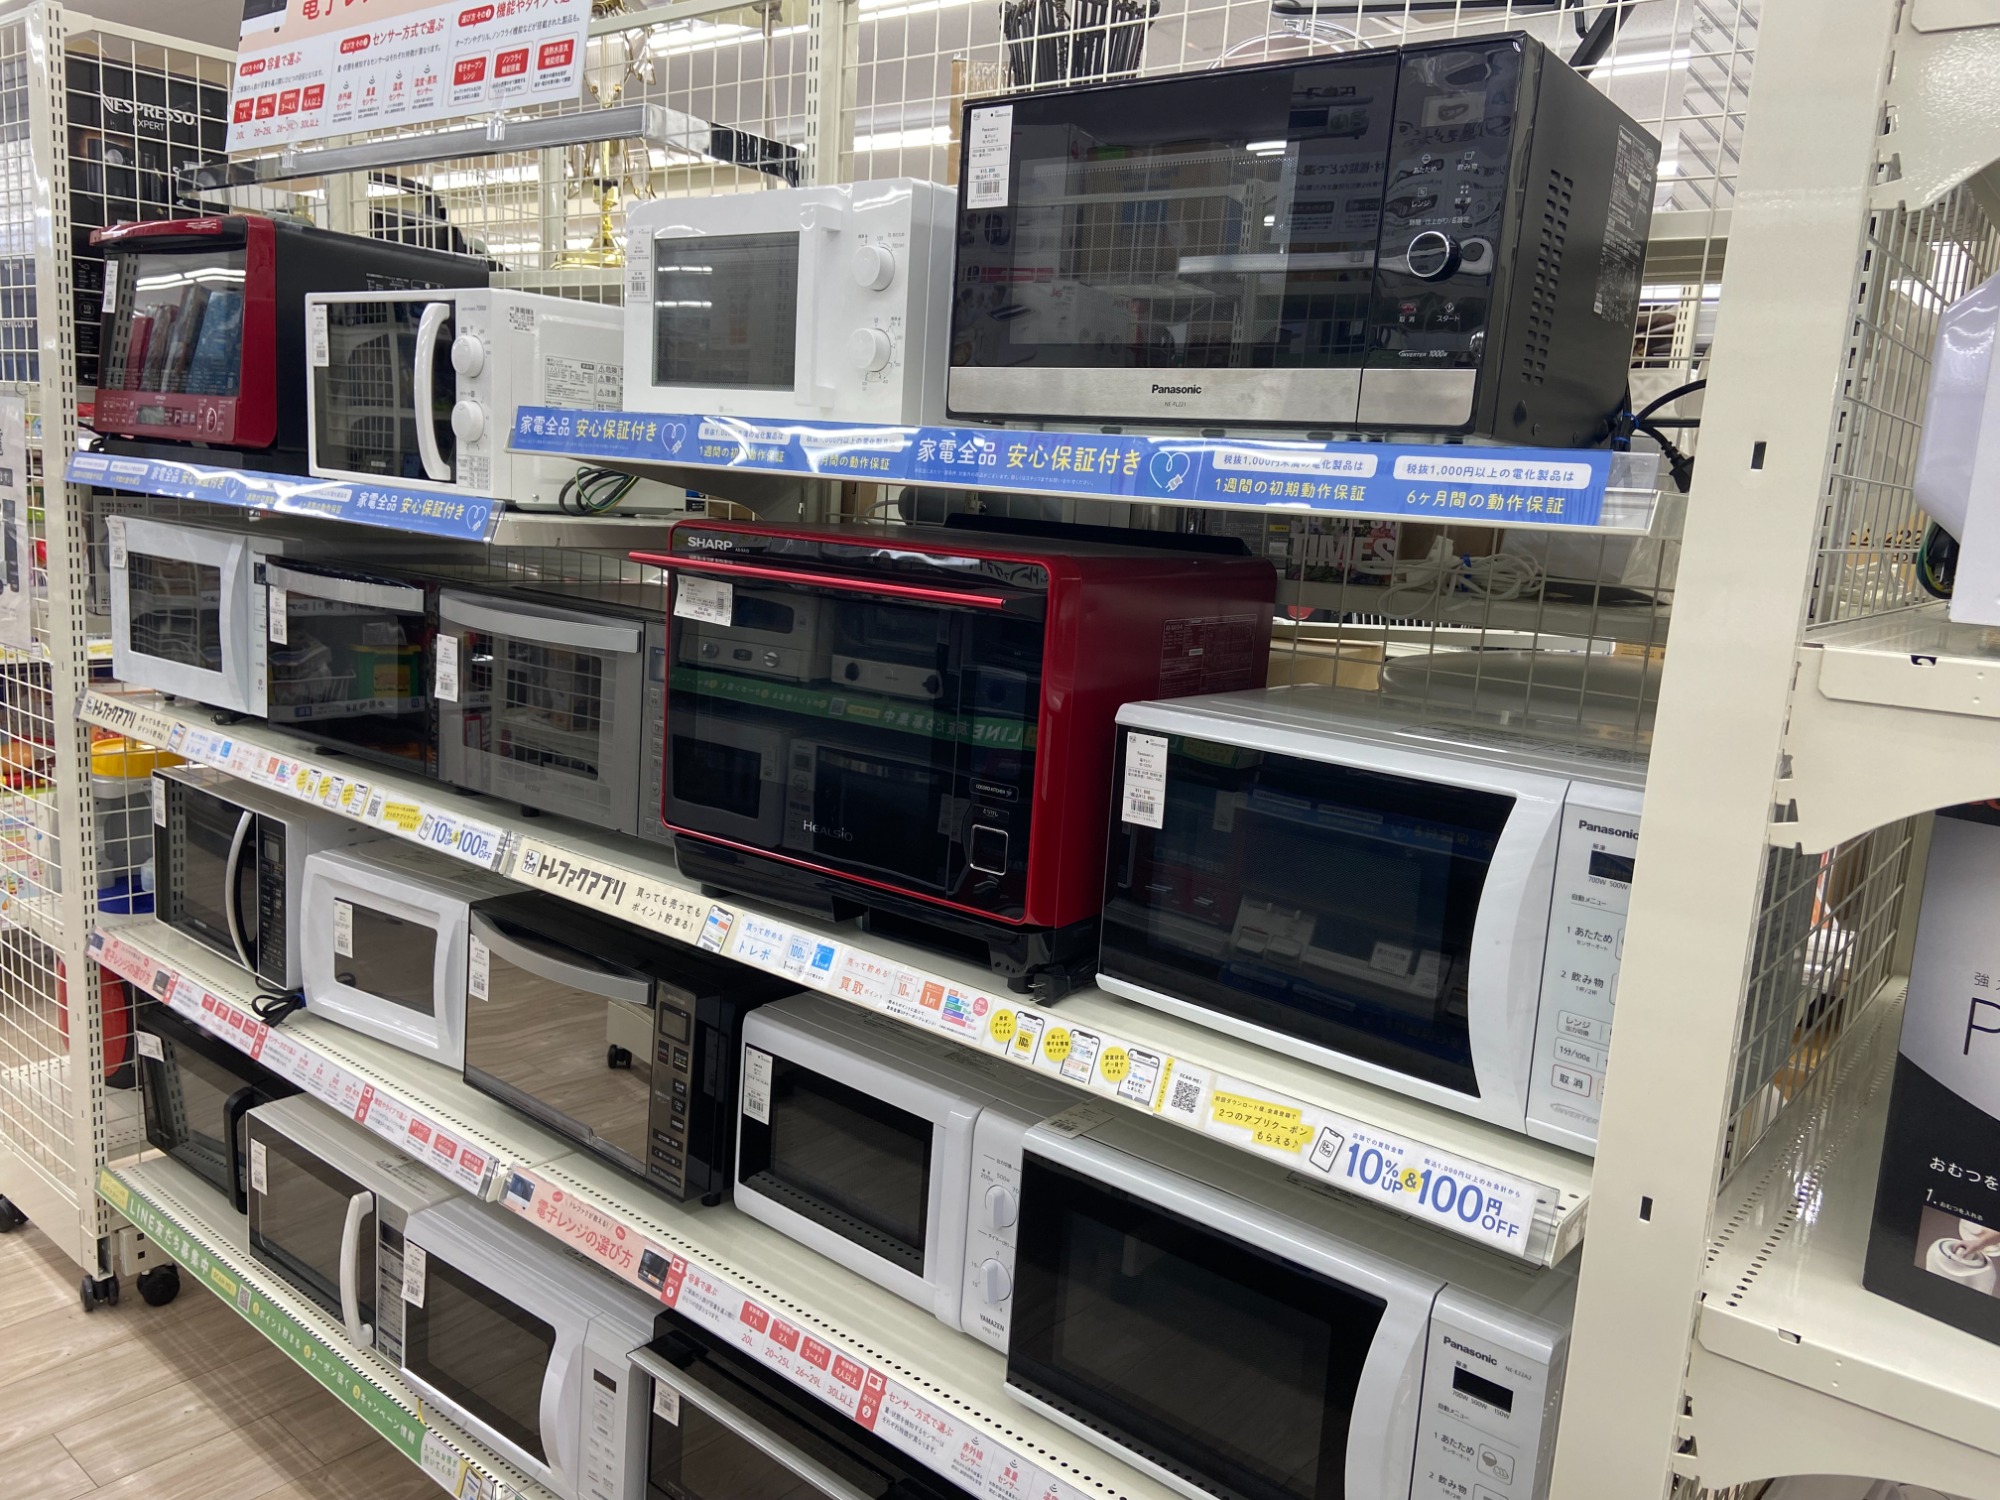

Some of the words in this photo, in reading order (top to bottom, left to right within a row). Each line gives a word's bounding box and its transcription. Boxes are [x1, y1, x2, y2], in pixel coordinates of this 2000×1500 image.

[373, 17, 445, 46] センサー方式で選ぶ
[463, 72, 476, 80] レンジ
[132, 118, 165, 132] XPERT
[1151, 384, 1203, 394] Panasonic
[520, 415, 570, 437] 家電全品
[576, 418, 657, 442] 安心保証付き
[916, 438, 997, 466] 家電全品
[1006, 443, 1141, 476] 安心保証付き
[1406, 463, 1575, 483] 税抜1,000円以上の電化製品は
[357, 491, 397, 513] 家電全品
[400, 496, 465, 521] 安心保証付き
[1215, 478, 1367, 502] 1週間の初期動作保証
[1407, 492, 1566, 515] 6ヶ月間の動作保証
[688, 536, 733, 551] SHARP
[432, 821, 448, 843] 10
[457, 830, 482, 856] 100
[1578, 819, 1640, 841] Panasonic
[478, 850, 493, 861] OFF
[537, 854, 627, 906] トレファクアプリ
[635, 886, 701, 918] 買っても売っても
[1588, 876, 1607, 886] 700W
[1609, 880, 1629, 891] 500W
[1571, 893, 1608, 906] 自動メニュー
[631, 902, 694, 933] ポイント貯まる!
[746, 922, 783, 942] 買って貯める
[1575, 927, 1614, 945] あたため
[1571, 971, 1604, 989] 飲み物
[1566, 1015, 1591, 1029] レンジ
[1218, 1108, 1309, 1137] 2つのアプリクーポン
[1346, 1143, 1384, 1185] 10
[1385, 1159, 1399, 1178] %
[1404, 1172, 1417, 1189] &
[1418, 1169, 1483, 1223] 100
[1486, 1197, 1503, 1217] 円
[1929, 1156, 1999, 1192] おむつを
[1381, 1176, 1404, 1194] UP
[1939, 1201, 1984, 1221] おむつを入れる
[536, 1198, 634, 1269] 電子レンジの選び方
[1481, 1216, 1520, 1239] OFF
[980, 1313, 1005, 1333] YAMAZEN
[741, 1332, 753, 1347] 20L
[1443, 1335, 1498, 1366] Panasonic
[827, 1384, 854, 1409] 30L以上
[889, 1392, 954, 1438] センサー方式で選ぶ
[1494, 1408, 1511, 1420] 150W
[962, 1441, 985, 1461] 赤外線
[1440, 1434, 1475, 1456] あたため
[959, 1452, 982, 1469] センサー
[997, 1474, 1020, 1493] センサー
[1438, 1474, 1467, 1495] 飲み物
